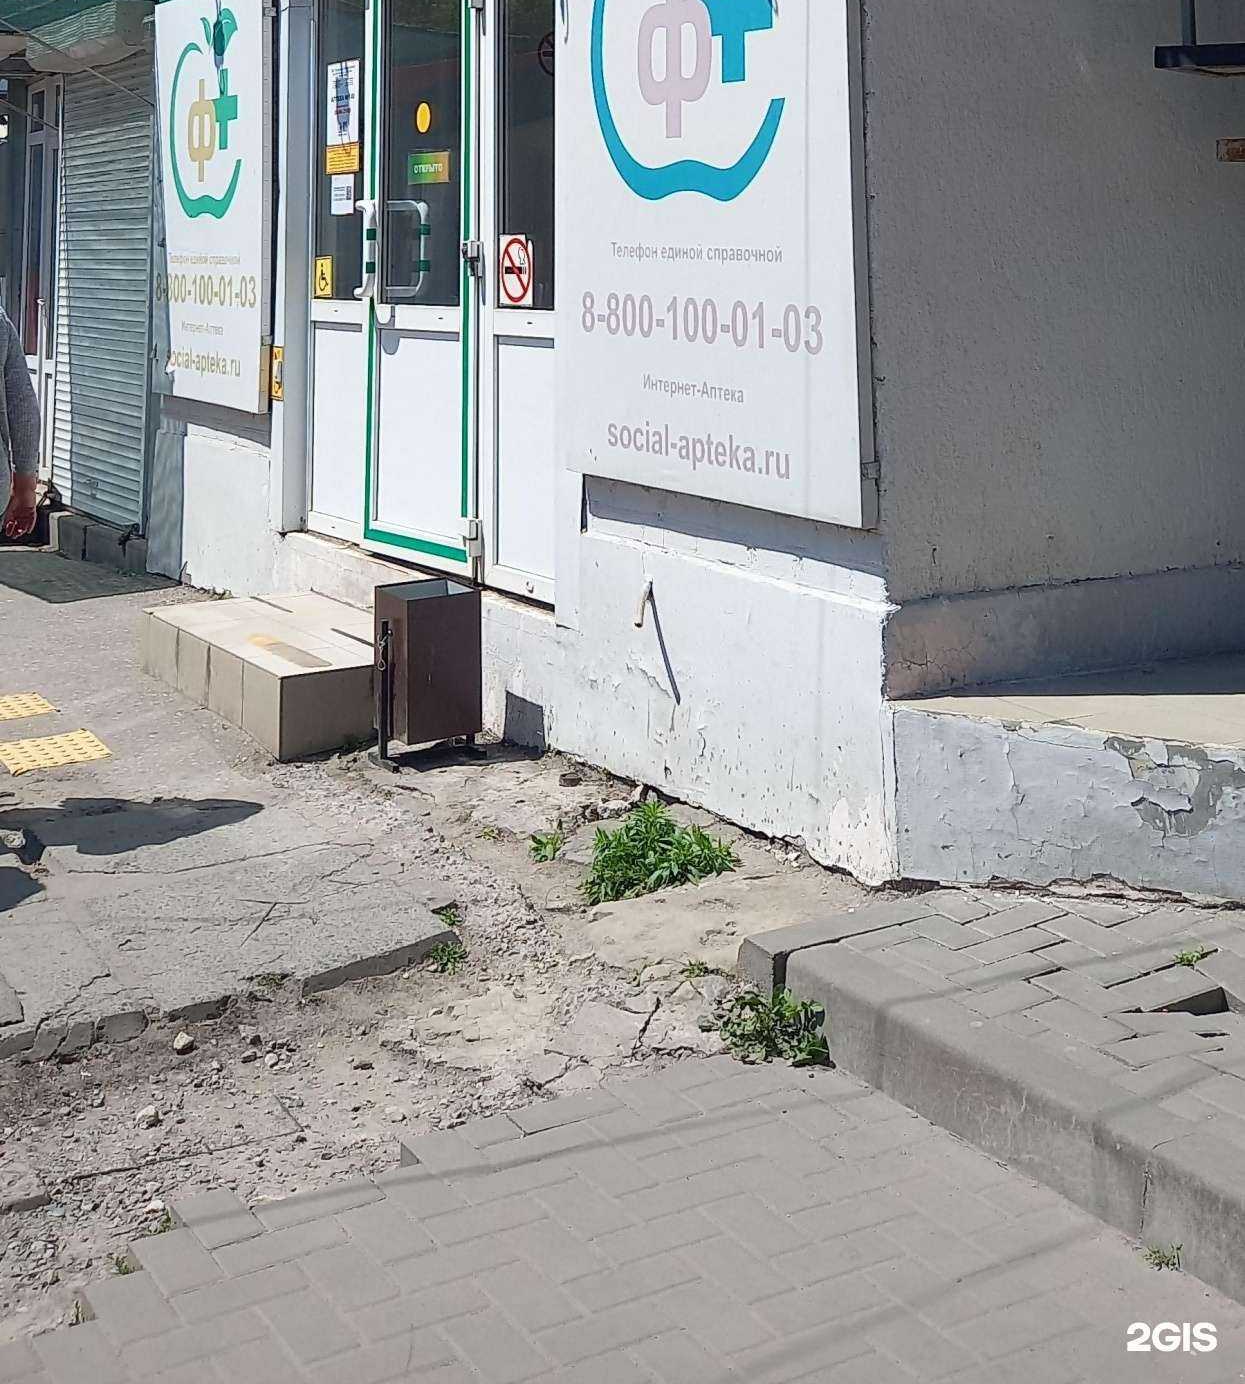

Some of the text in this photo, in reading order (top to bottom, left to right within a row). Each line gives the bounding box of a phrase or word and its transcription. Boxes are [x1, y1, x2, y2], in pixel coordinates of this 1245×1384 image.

[413, 163, 443, 174] ОТКРЫТО
[611, 242, 783, 264] Телефон единой справочной
[581, 290, 823, 355] 8-800-100-01-03
[643, 374, 744, 403] Интернет-Аптека
[607, 420, 790, 480] social-apteka.ru
